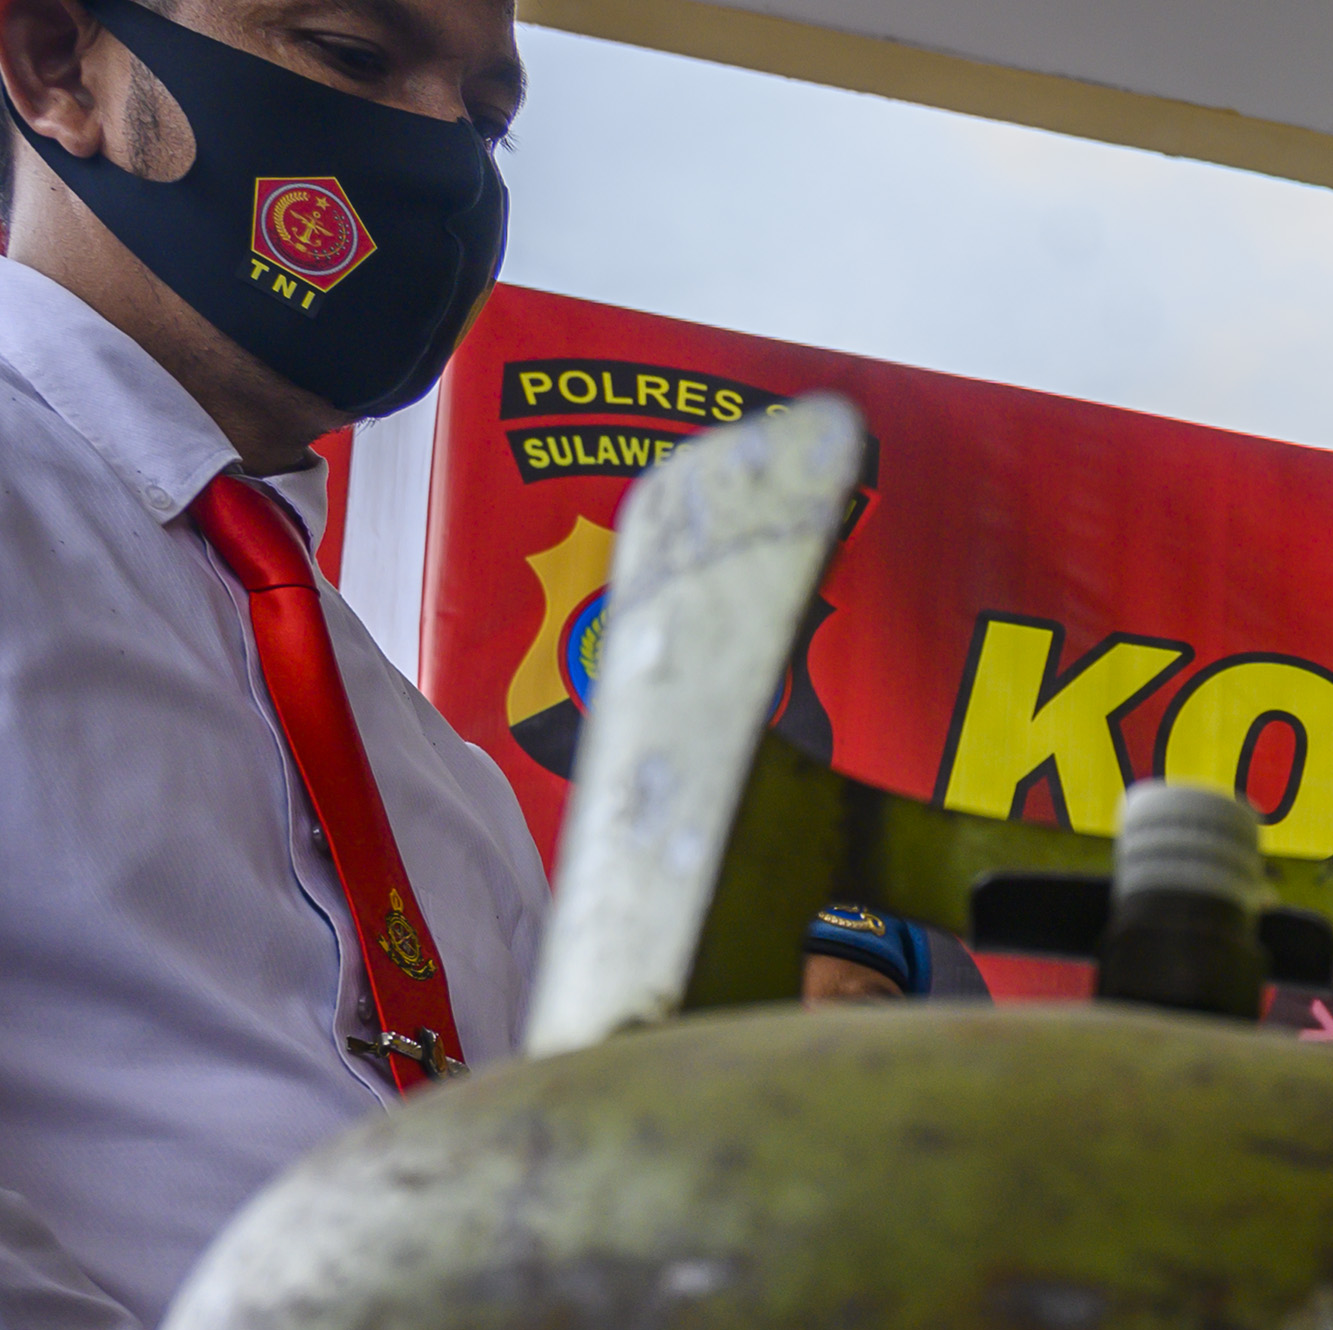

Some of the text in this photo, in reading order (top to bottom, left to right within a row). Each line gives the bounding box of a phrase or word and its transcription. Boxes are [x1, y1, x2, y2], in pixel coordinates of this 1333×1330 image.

[250, 258, 316, 310] TNI
[519, 370, 744, 422] POLRES
[523, 434, 690, 469] SULAWE
